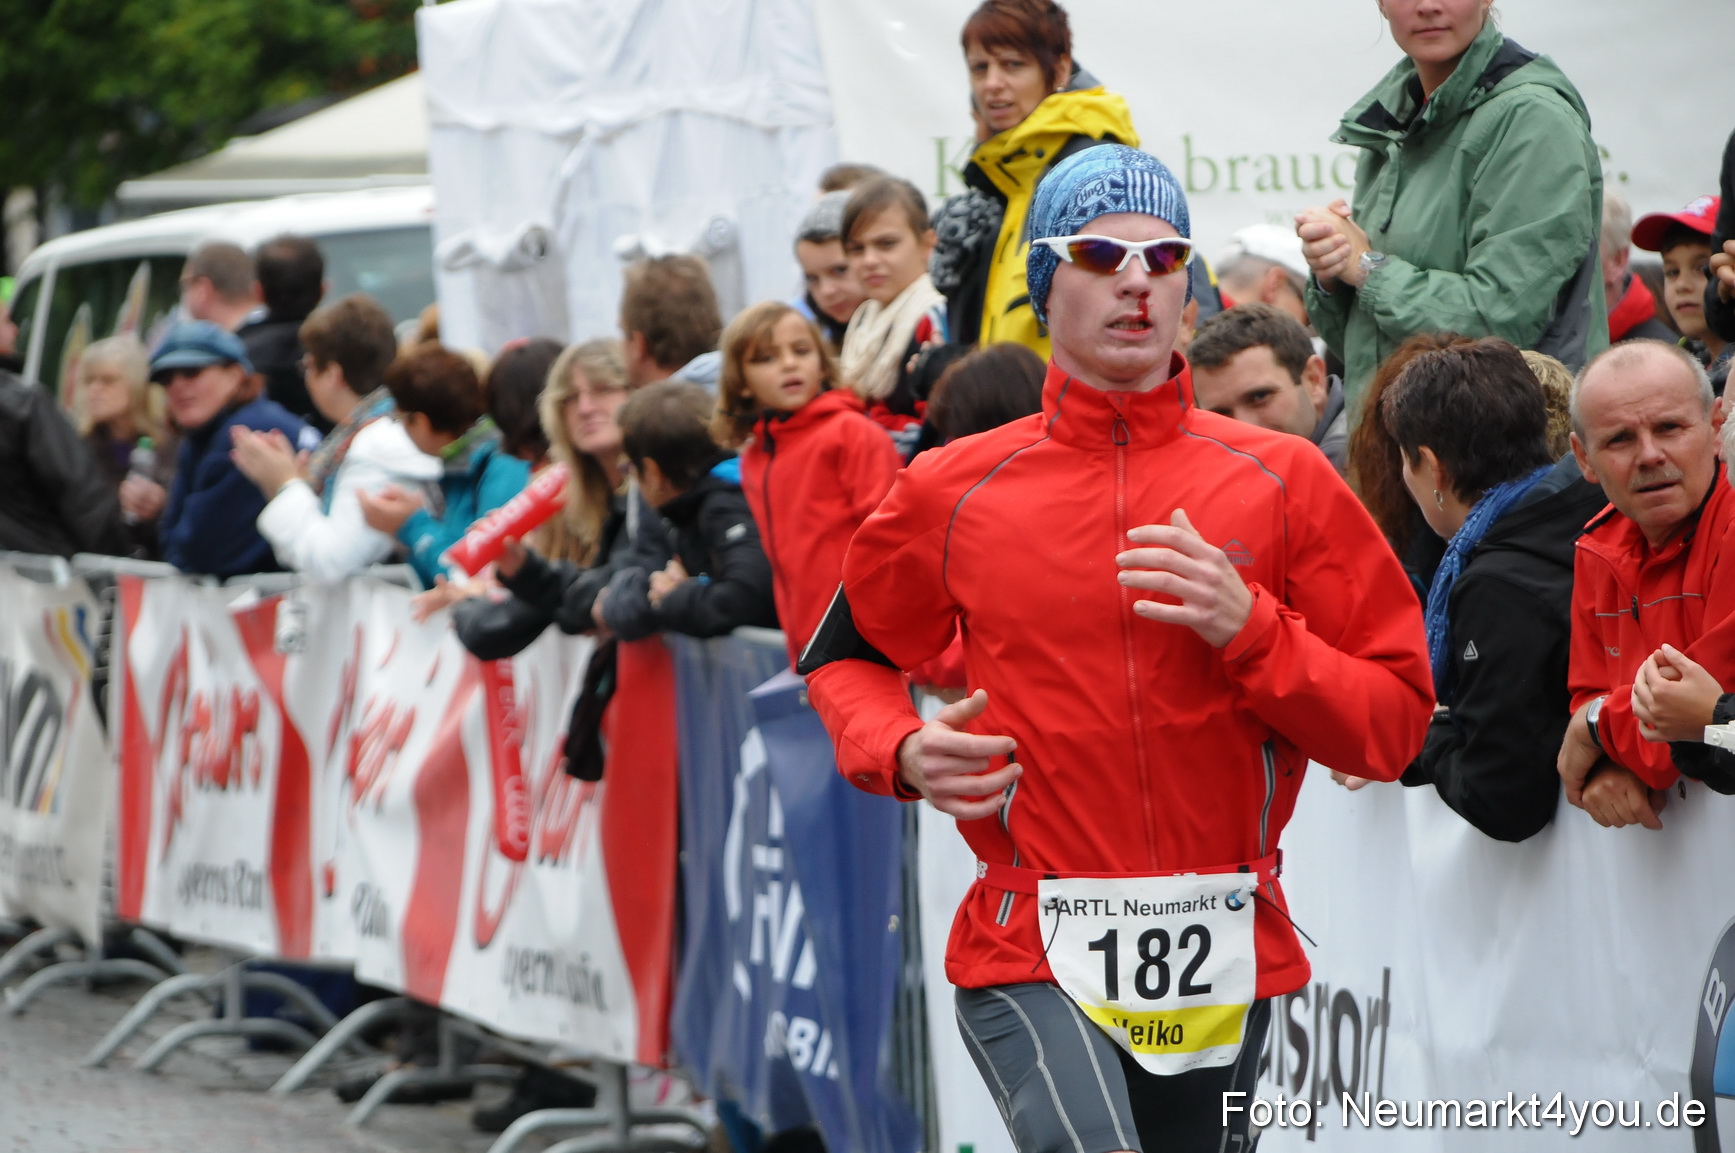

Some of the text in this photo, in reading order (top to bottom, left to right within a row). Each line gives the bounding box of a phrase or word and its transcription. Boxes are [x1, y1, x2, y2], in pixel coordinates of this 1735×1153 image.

[1182, 134, 1358, 194] brauc
[1124, 895, 1217, 917] Neumarkt
[1088, 923, 1213, 1001] 182
